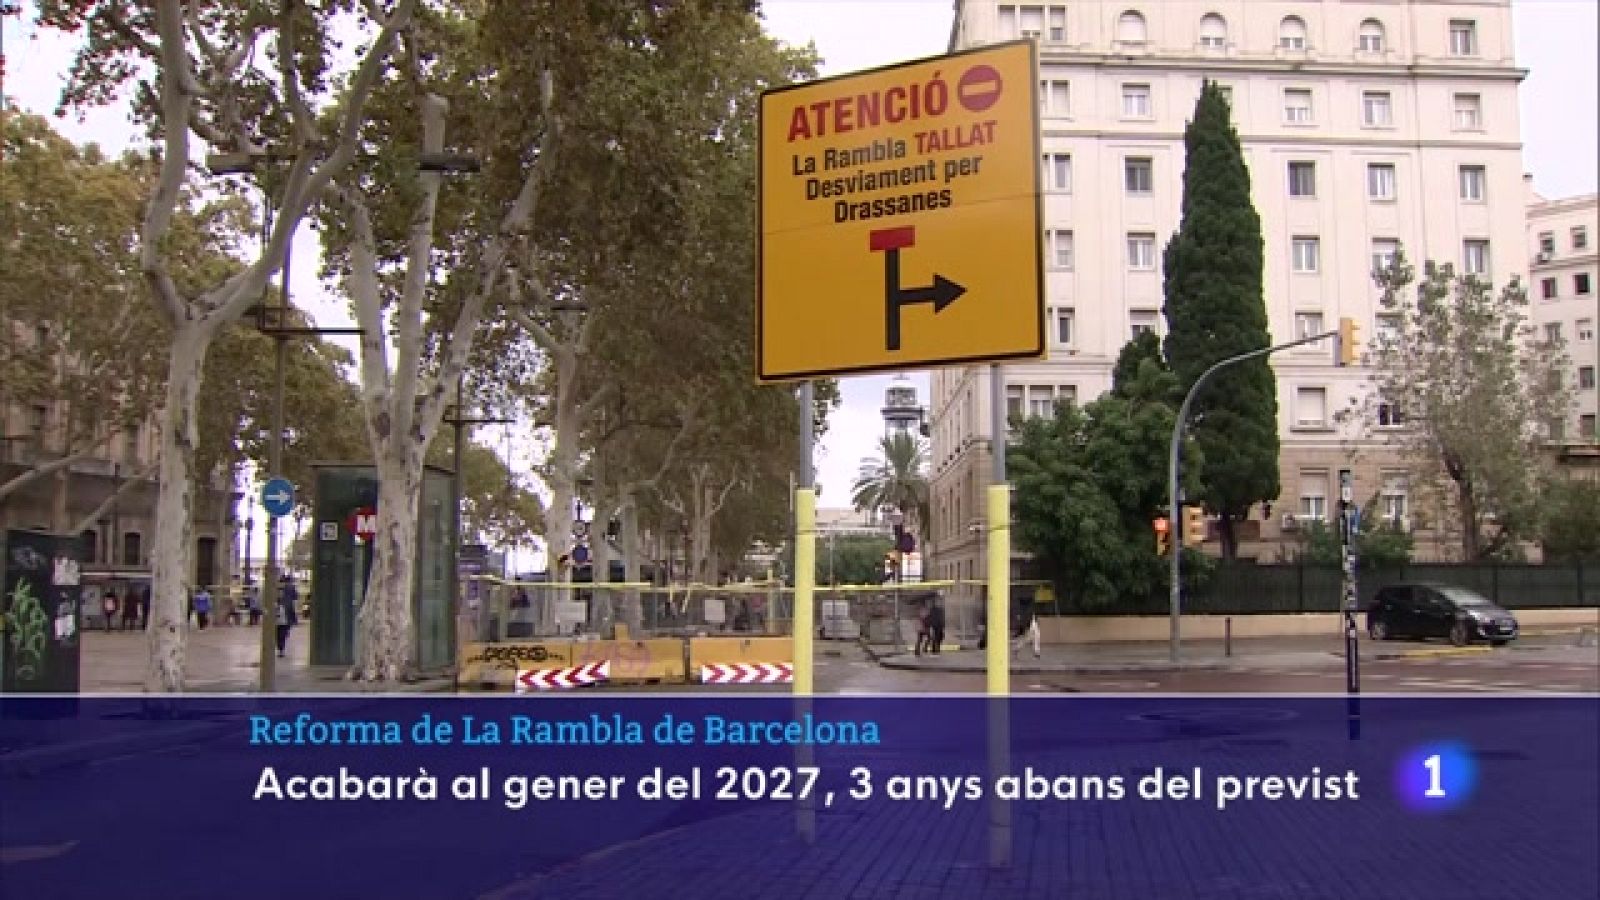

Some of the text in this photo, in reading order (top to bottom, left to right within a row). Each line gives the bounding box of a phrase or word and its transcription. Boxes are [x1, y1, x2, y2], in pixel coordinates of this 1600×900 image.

[788, 70, 949, 142] ATENCIÓ
[792, 120, 998, 176] La Rambla TALLAT
[806, 154, 983, 201] Desviament per
[834, 189, 953, 223] Drassanes
[356, 514, 377, 533] M
